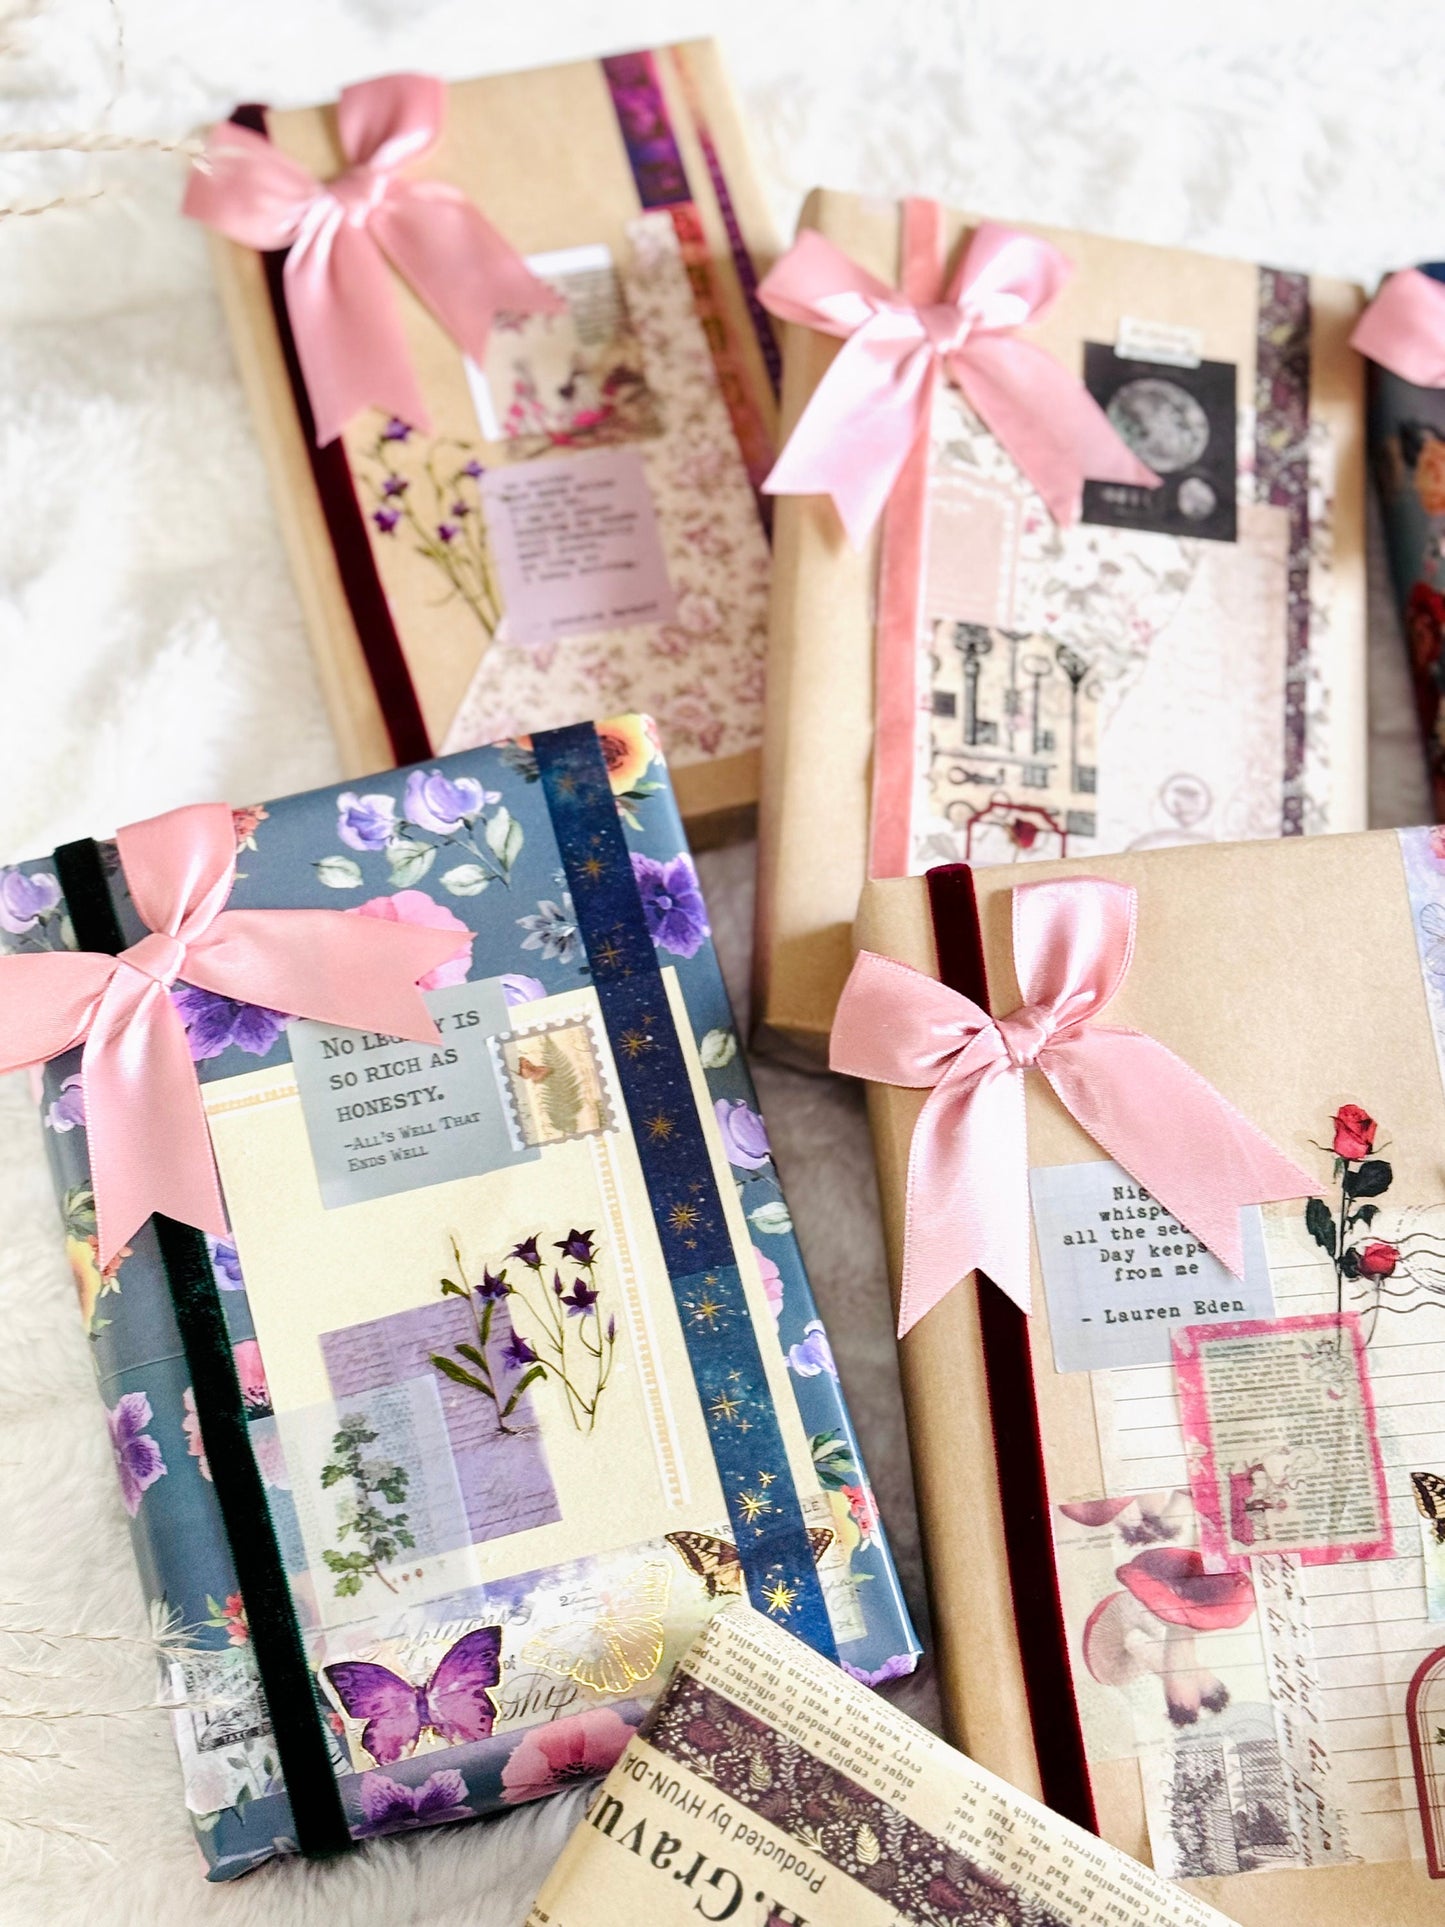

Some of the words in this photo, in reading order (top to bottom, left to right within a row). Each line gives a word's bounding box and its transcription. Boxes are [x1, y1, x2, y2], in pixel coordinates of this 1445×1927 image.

[454, 1011, 480, 1029] IS
[330, 1072, 357, 1090] SO
[366, 1057, 422, 1084] RICH
[430, 1049, 459, 1068] AS
[337, 1086, 445, 1123] HONESTY.
[1113, 1186, 1151, 1201] Nig
[1099, 1206, 1171, 1222] whispe
[1063, 1231, 1098, 1246] all
[1111, 1226, 1145, 1241] the
[1101, 1248, 1135, 1263] Day
[1149, 1242, 1207, 1258] keeps
[1115, 1268, 1163, 1282] from
[1176, 1265, 1199, 1276] me
[1105, 1308, 1181, 1324] Lauren
[1194, 1299, 1245, 1315] Eden
[722, 1646, 756, 1673] horse
[759, 1668, 780, 1687] the
[785, 1666, 830, 1700] veteran
[783, 1683, 798, 1698] to
[703, 1668, 809, 1744] time-management
[777, 1697, 796, 1715] by
[801, 1695, 830, 1718] went
[842, 1702, 870, 1725] with
[794, 1708, 852, 1751] mmended
[872, 1721, 902, 1745] went
[824, 1745, 870, 1781] employ
[853, 1745, 880, 1767] reco
[889, 1749, 923, 1776] every
[871, 1777, 887, 1792] to
[880, 1762, 915, 1790] nique
[889, 1788, 907, 1805] ed
[960, 1791, 978, 1807] we
[989, 1791, 1009, 1808] we
[703, 1800, 736, 1833] by
[951, 1805, 975, 1825] one
[984, 1807, 1017, 1835] Thus
[1010, 1805, 1048, 1835] which
[943, 1820, 956, 1834] it
[957, 1828, 982, 1850] and
[729, 1818, 828, 1896] Producted
[1014, 1845, 1037, 1865] bet
[1058, 1853, 1075, 1870] to
[1007, 1859, 1024, 1875] to
[1044, 1864, 1070, 1887] had
[1024, 1870, 1052, 1893] next
[1076, 1884, 1095, 1902] he
[1081, 1867, 1151, 1918] Convention
[1117, 1871, 1168, 1908] common
[1054, 1888, 1088, 1916] down
[1103, 1900, 1130, 1924] that
